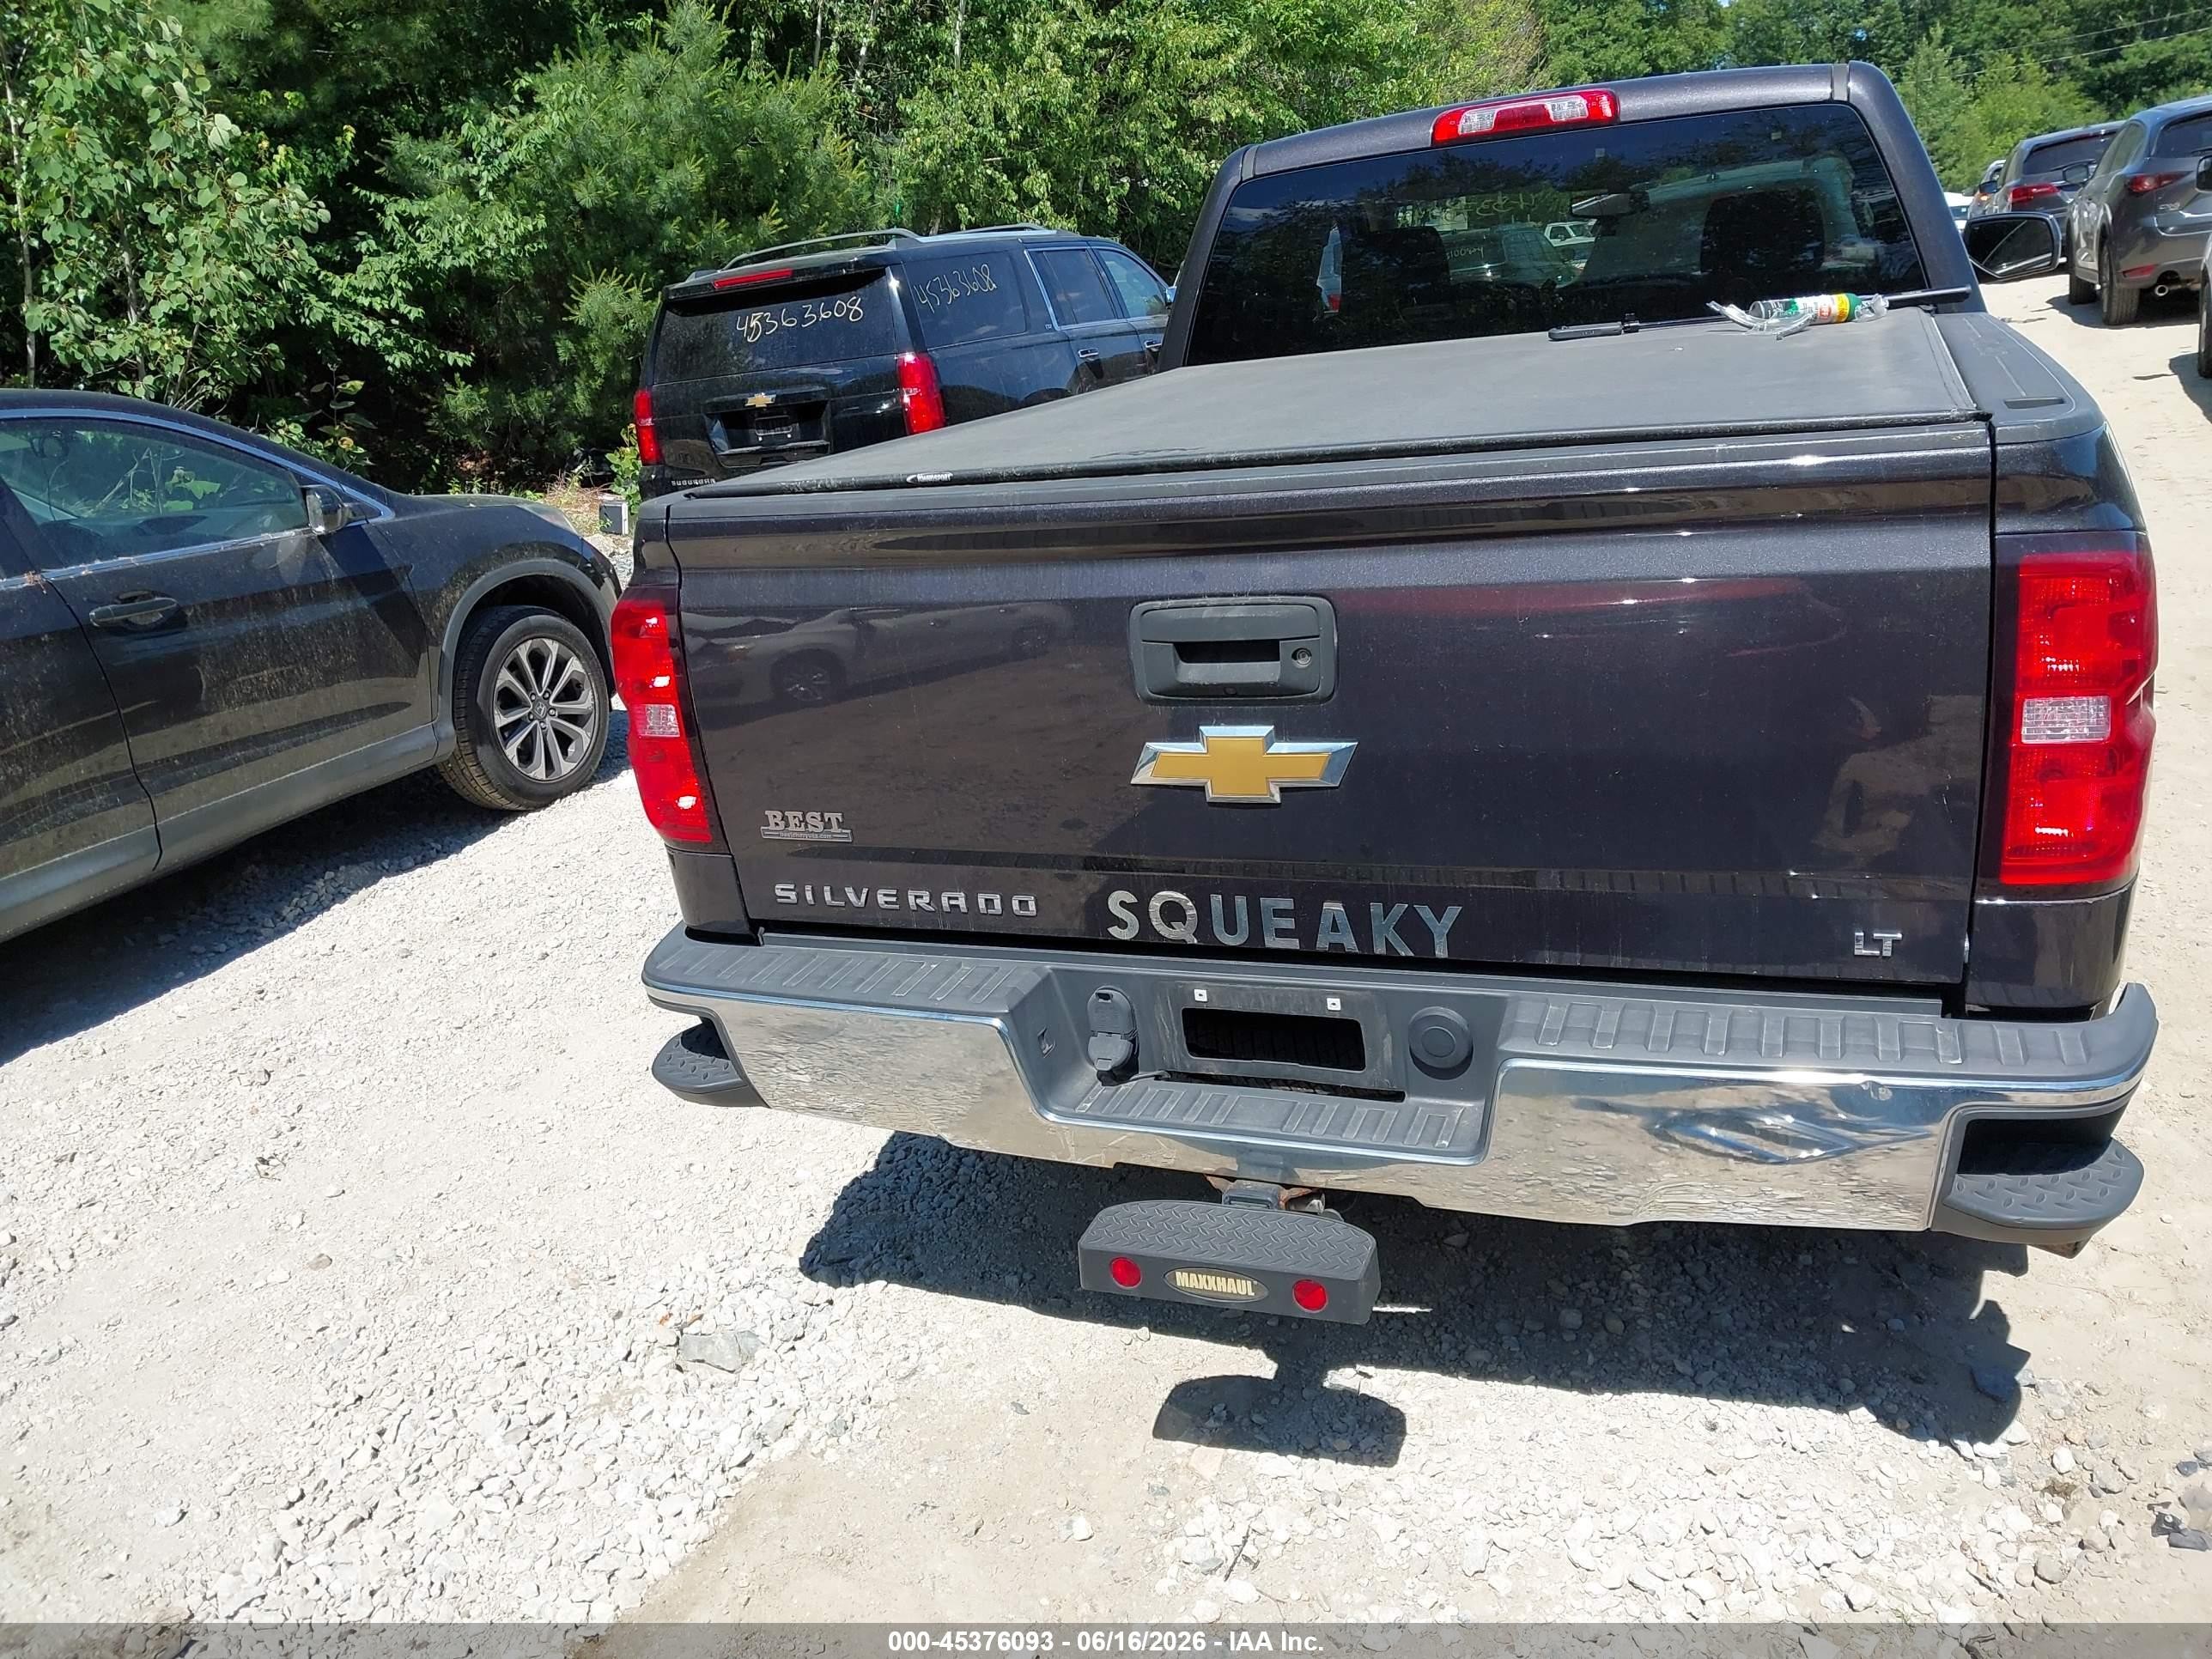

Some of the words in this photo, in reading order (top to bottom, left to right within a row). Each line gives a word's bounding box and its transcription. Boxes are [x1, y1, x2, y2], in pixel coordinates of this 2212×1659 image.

[736, 296, 864, 343] 45363608
[764, 810, 842, 833] BEST
[775, 884, 1037, 916] SILVERADO
[1106, 890, 1463, 958] SQUEAKY
[1854, 932, 1903, 957] LT
[1175, 1271, 1255, 1297] MAXXHAUL
